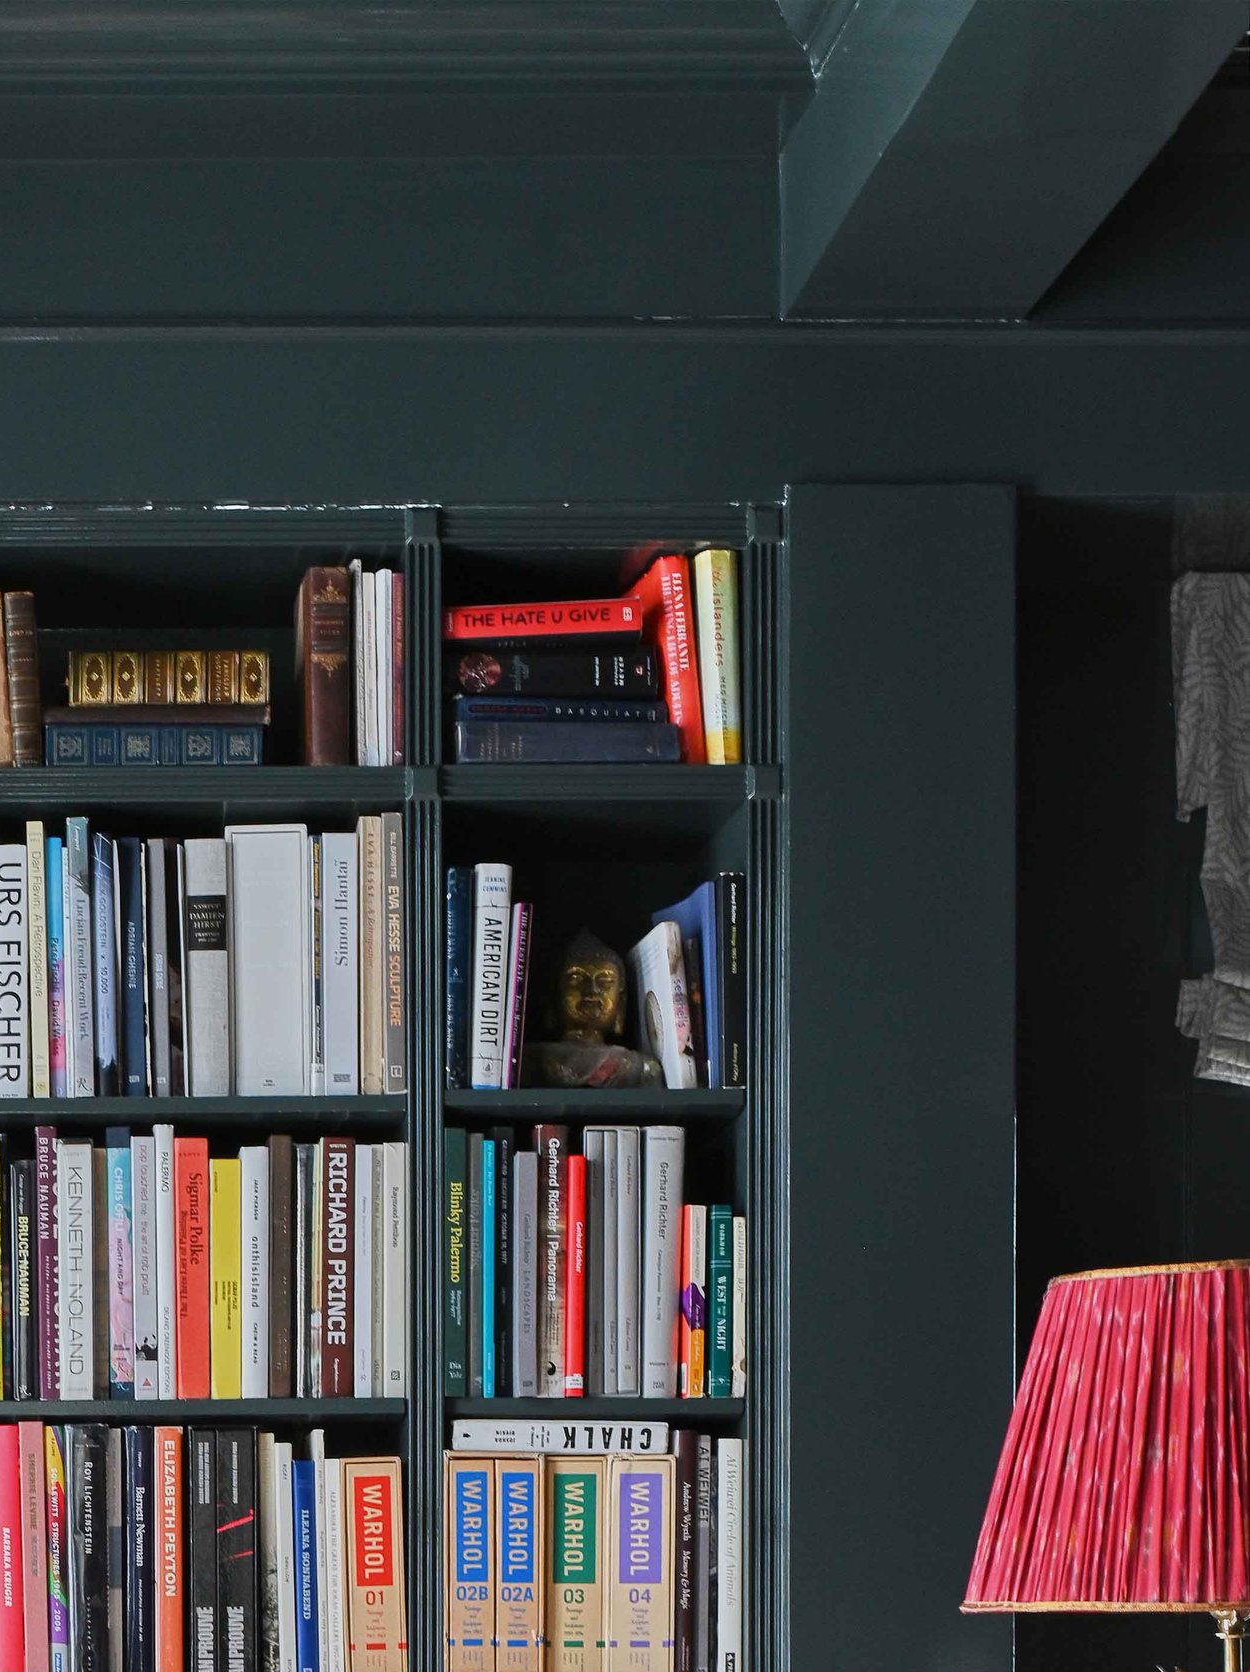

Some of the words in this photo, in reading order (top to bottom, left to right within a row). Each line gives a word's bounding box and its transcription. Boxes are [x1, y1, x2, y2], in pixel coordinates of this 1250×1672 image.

[463, 612, 494, 628] THE
[502, 610, 545, 625] HATE
[551, 608, 563, 622] U
[568, 605, 610, 621] GIVE
[713, 592, 727, 667] islanders
[388, 885, 400, 910] EVA
[333, 916, 349, 967] Simon
[389, 913, 401, 953] HESSE
[481, 917, 503, 1003] AMERICAN
[390, 954, 402, 1027] SCULPTURE
[480, 1009, 500, 1047] DIRT
[39, 1136, 49, 1179] BRUCE
[547, 1137, 561, 1187] Gerhard
[39, 1184, 49, 1239] NAUMAN
[68, 1165, 84, 1272] KENNETH
[186, 1171, 203, 1222] Sigmar
[328, 1151, 348, 1253] RICHARD
[447, 1181, 464, 1226] Blinky
[547, 1188, 561, 1232] Richter
[189, 1224, 203, 1266] Polke
[450, 1226, 463, 1283] Palermo
[546, 1240, 561, 1302] Panorama
[327, 1259, 347, 1345] PRINCE
[68, 1282, 84, 1376] NOLAND
[562, 1425, 653, 1451] CHALK
[163, 1439, 176, 1529] ELIZABETH
[363, 1483, 385, 1580] WARHOL
[463, 1480, 483, 1575] WARHOL
[508, 1481, 528, 1576] WARHOL
[563, 1482, 584, 1577] WARHOL
[629, 1482, 650, 1576] WARHOL
[163, 1531, 177, 1597] PEYTON
[366, 1590, 384, 1606] 01
[456, 1586, 488, 1602] 02B
[501, 1587, 533, 1602] 02A
[563, 1588, 584, 1604] 03
[628, 1588, 651, 1604] 04
